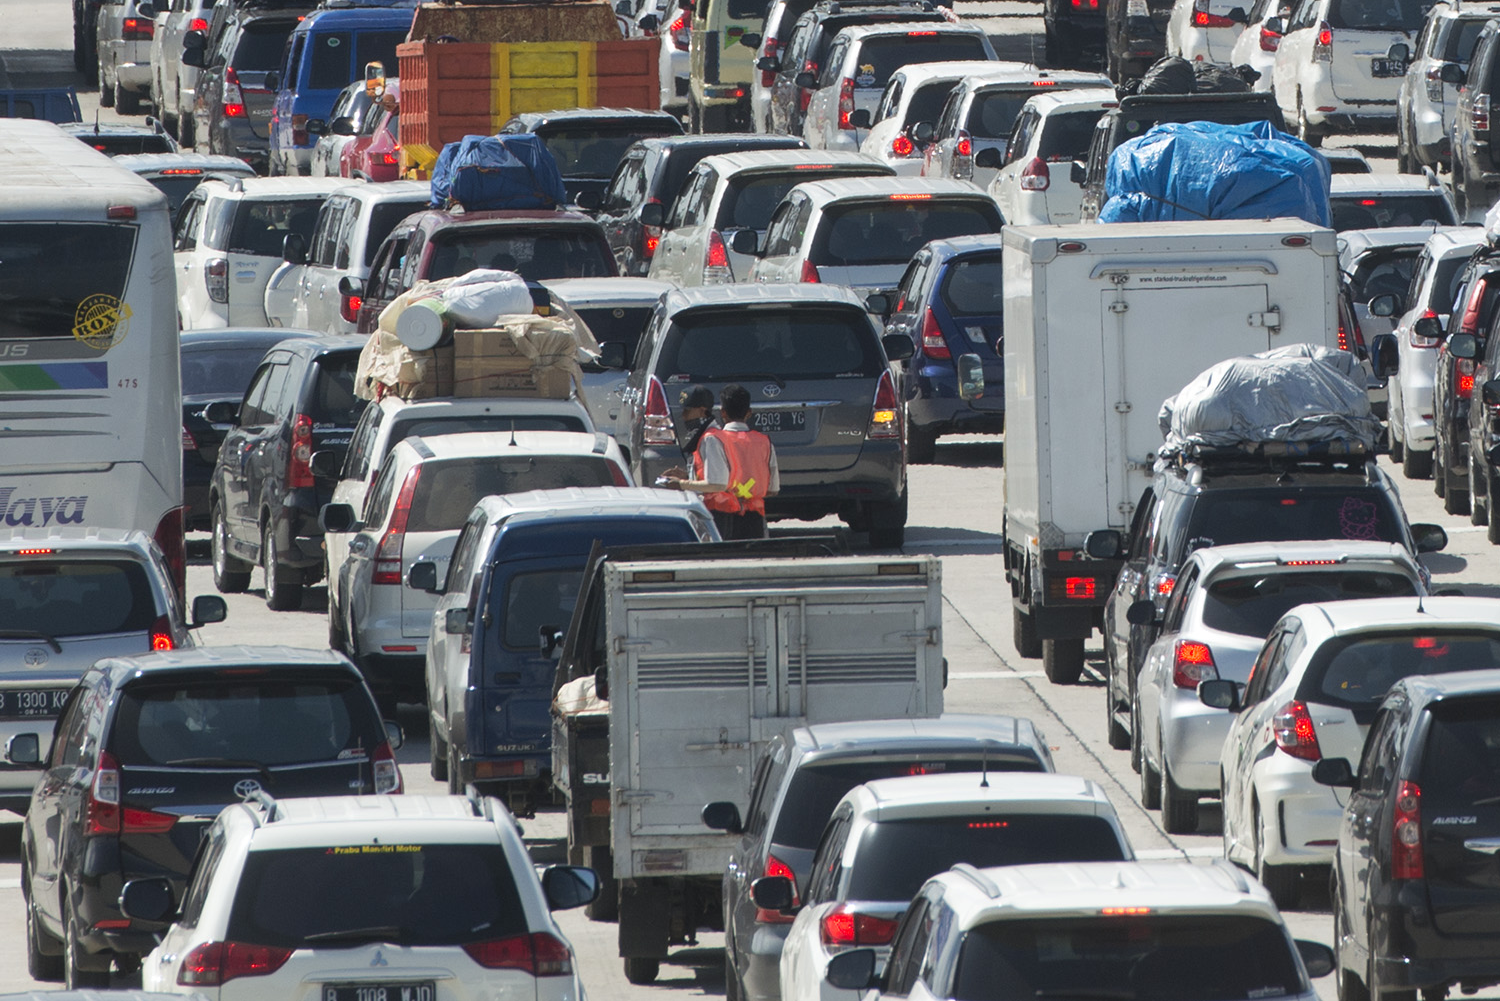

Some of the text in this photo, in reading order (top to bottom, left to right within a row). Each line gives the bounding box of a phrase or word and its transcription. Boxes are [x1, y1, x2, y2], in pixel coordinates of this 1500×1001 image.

[754, 411, 804, 426] 2603 YG
[18, 692, 46, 707] 1300
[128, 787, 176, 795] AVANZA
[1433, 816, 1477, 825] AVANZA
[334, 846, 360, 855] Prabu
[362, 845, 394, 853] Mandiri
[327, 985, 336, 1001] B
[356, 985, 386, 1001] 1108
